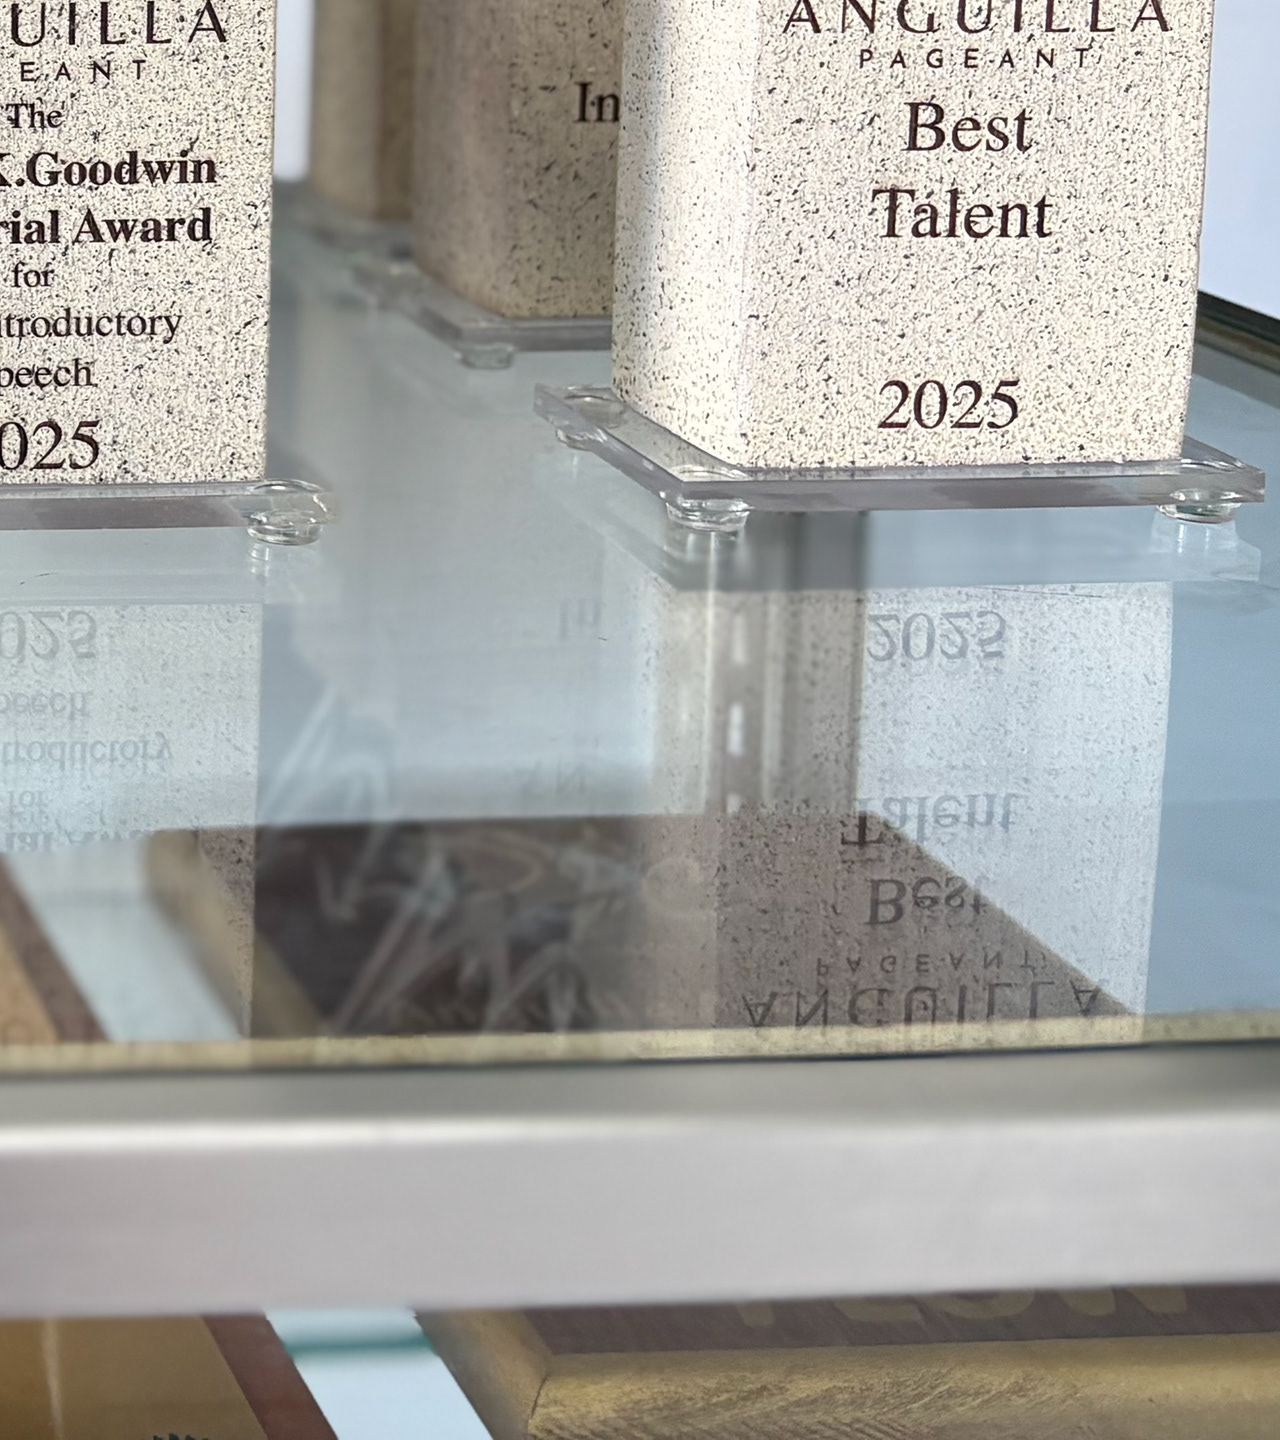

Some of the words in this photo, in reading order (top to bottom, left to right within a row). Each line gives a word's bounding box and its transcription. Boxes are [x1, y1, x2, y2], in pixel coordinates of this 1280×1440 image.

[858, 47, 1091, 70] PAGEANT
[5, 101, 63, 130] The
[905, 100, 1034, 154] Best
[71, 206, 213, 244] Award
[870, 187, 1054, 239] Talent
[11, 262, 54, 288] for
[878, 378, 1020, 430] 2025
